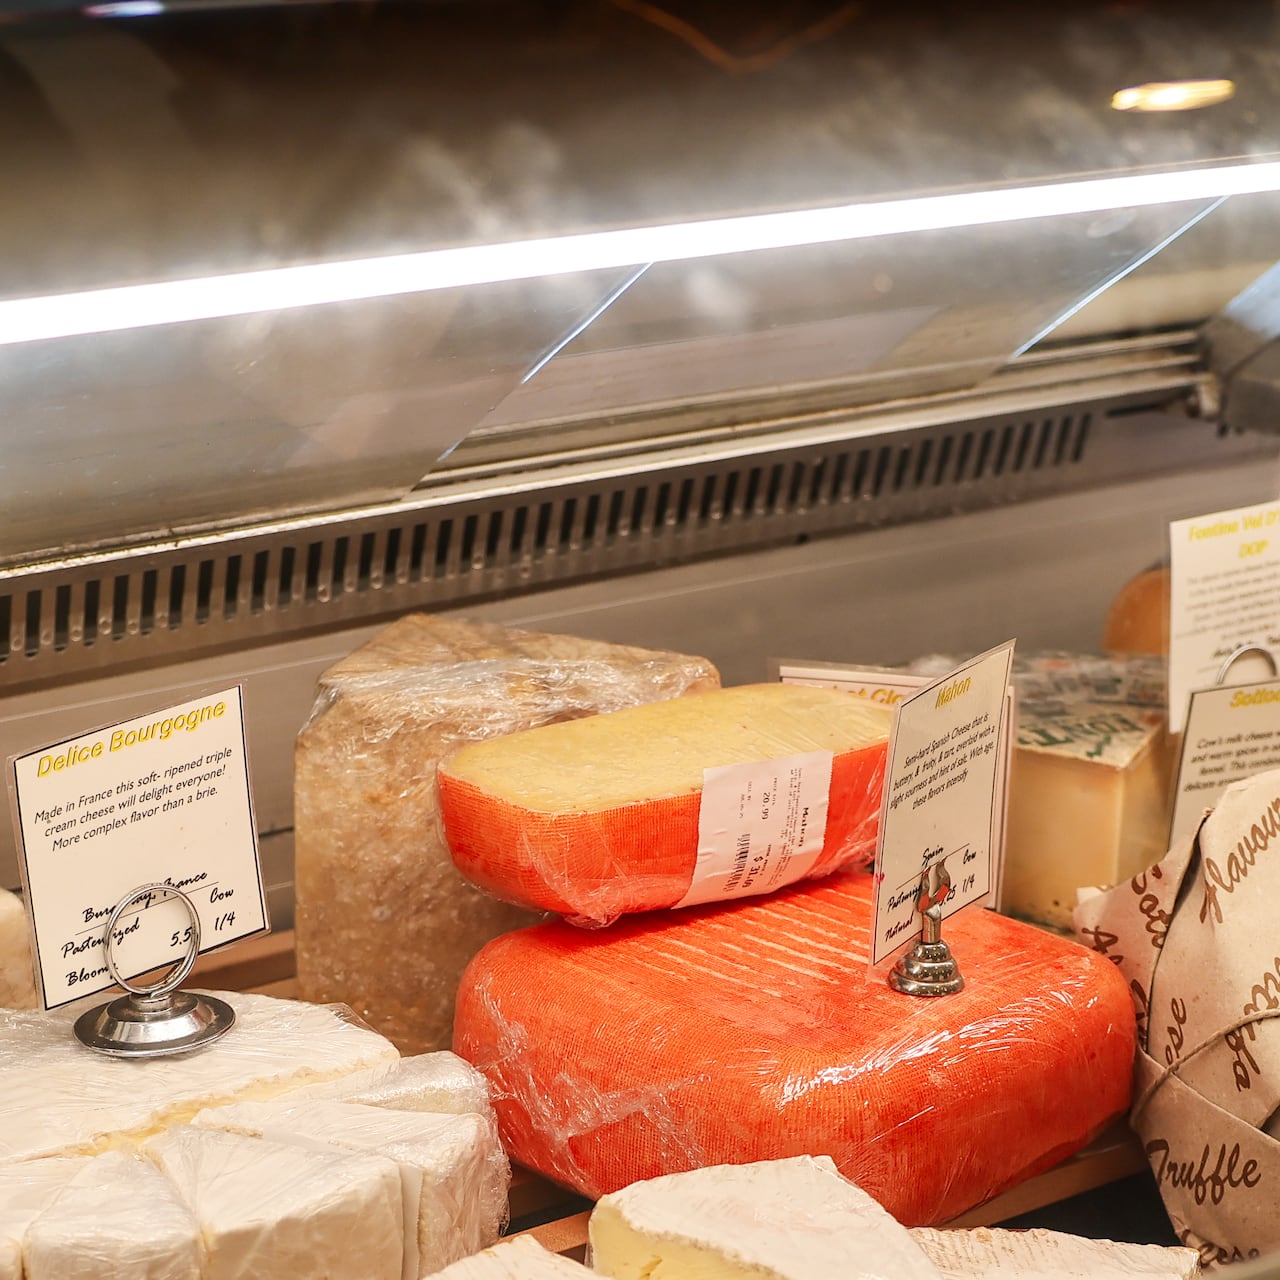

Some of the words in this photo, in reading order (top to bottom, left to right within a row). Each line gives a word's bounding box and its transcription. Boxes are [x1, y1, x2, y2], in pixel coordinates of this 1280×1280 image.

[935, 677, 972, 709] Mahon
[37, 741, 105, 778] Delice
[110, 702, 227, 753] Bourgogne
[34, 805, 63, 824] Made
[65, 801, 75, 812] in
[78, 789, 113, 808] France
[116, 781, 134, 794] this
[163, 755, 203, 779] ripened
[205, 747, 232, 764] triple
[44, 818, 77, 837] cream
[79, 805, 115, 824] cheese
[118, 794, 136, 810] will
[138, 784, 173, 803] delight
[175, 763, 226, 791] everyone!
[52, 834, 80, 852] More
[83, 817, 127, 840] complex
[130, 806, 160, 823] flavor
[162, 798, 184, 812] than
[187, 795, 193, 804] a
[195, 786, 218, 801] brie.
[209, 887, 234, 903] Cow
[962, 873, 975, 893] 1/4
[214, 911, 235, 931] 1/4
[885, 910, 914, 942] Natural
[1145, 1138, 1262, 1206] Truffle
